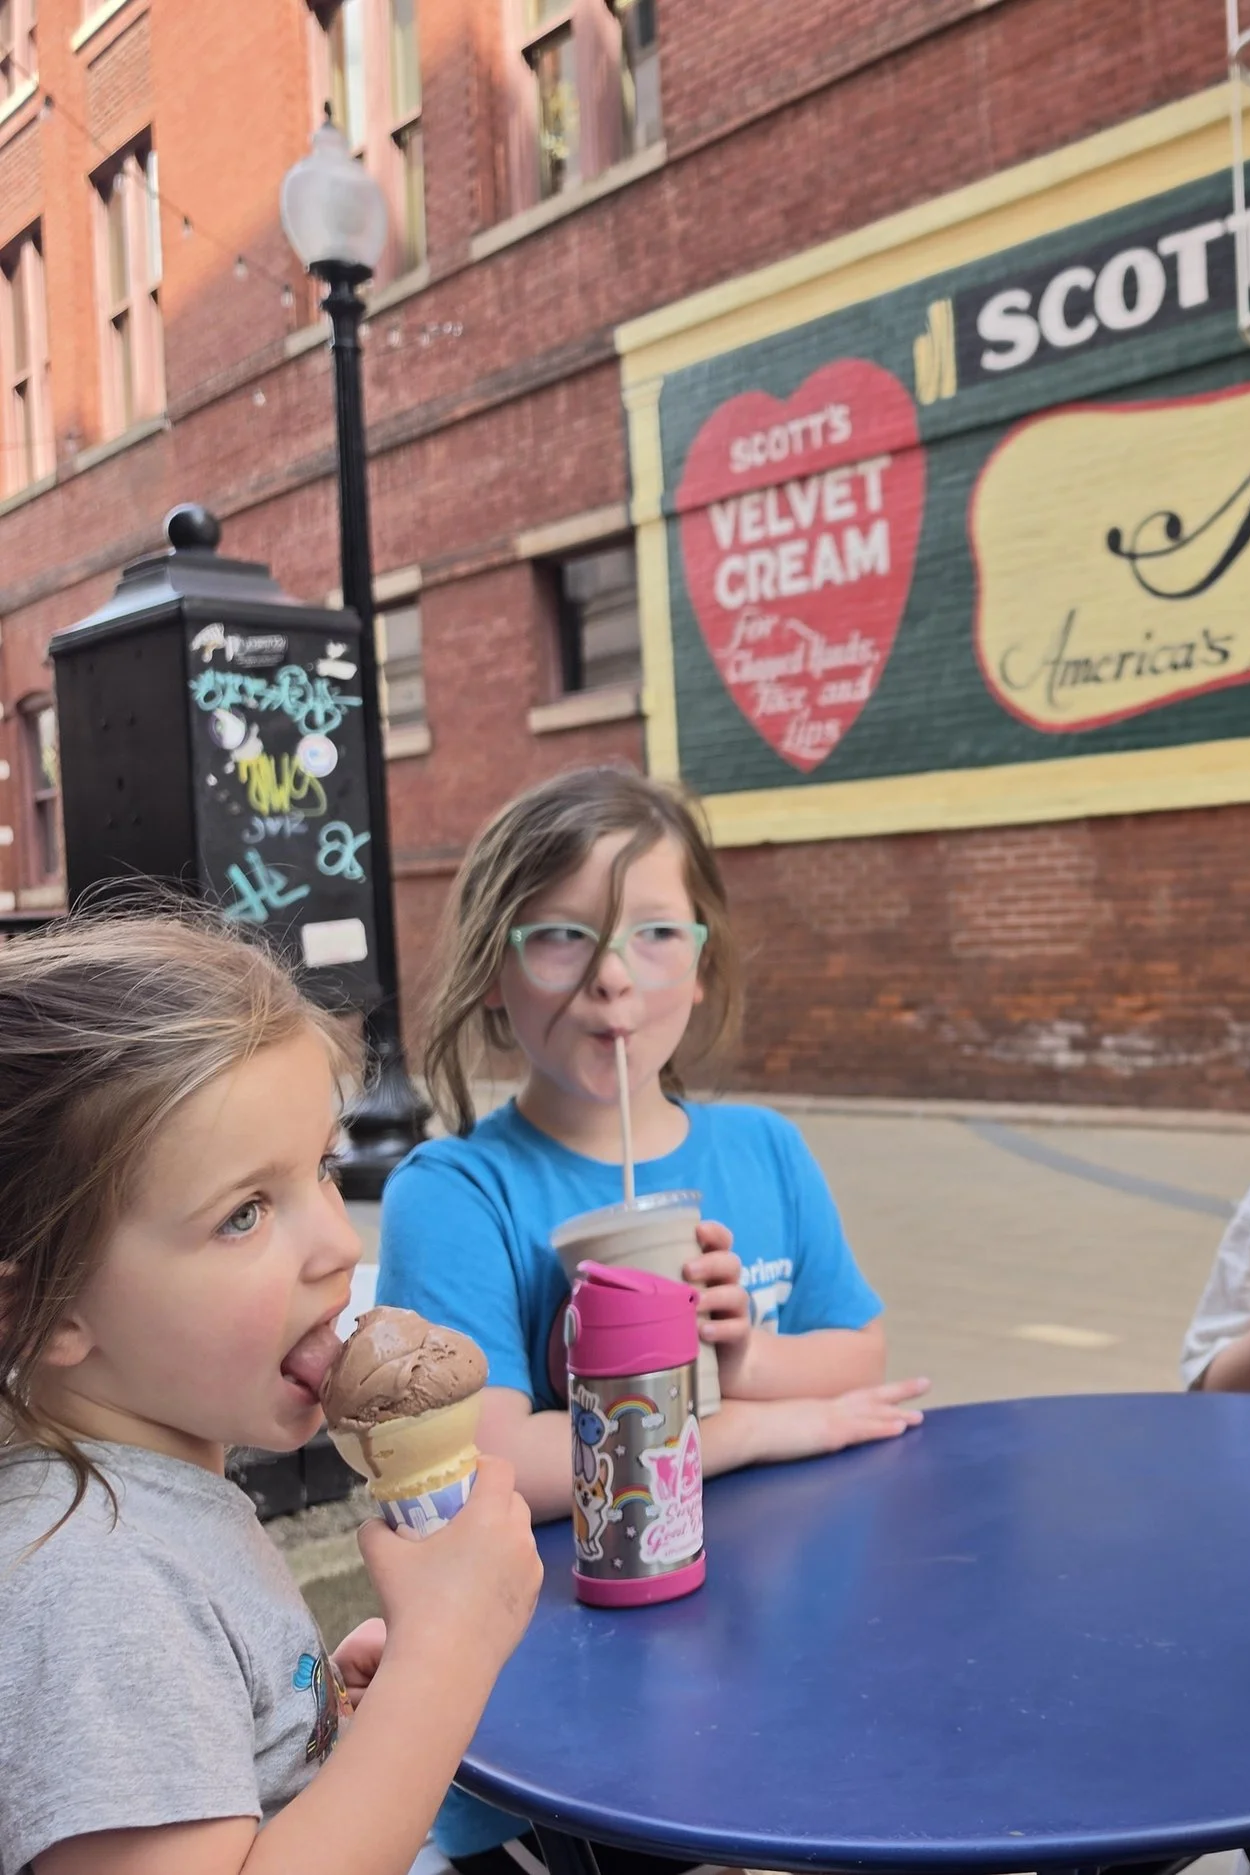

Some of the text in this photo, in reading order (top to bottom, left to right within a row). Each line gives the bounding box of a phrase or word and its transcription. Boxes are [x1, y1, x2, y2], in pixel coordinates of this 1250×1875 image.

[730, 403, 852, 473] SCOTT'S
[708, 455, 892, 549] VELVET
[715, 519, 890, 609] CREAM
[1000, 609, 1232, 709] America's
